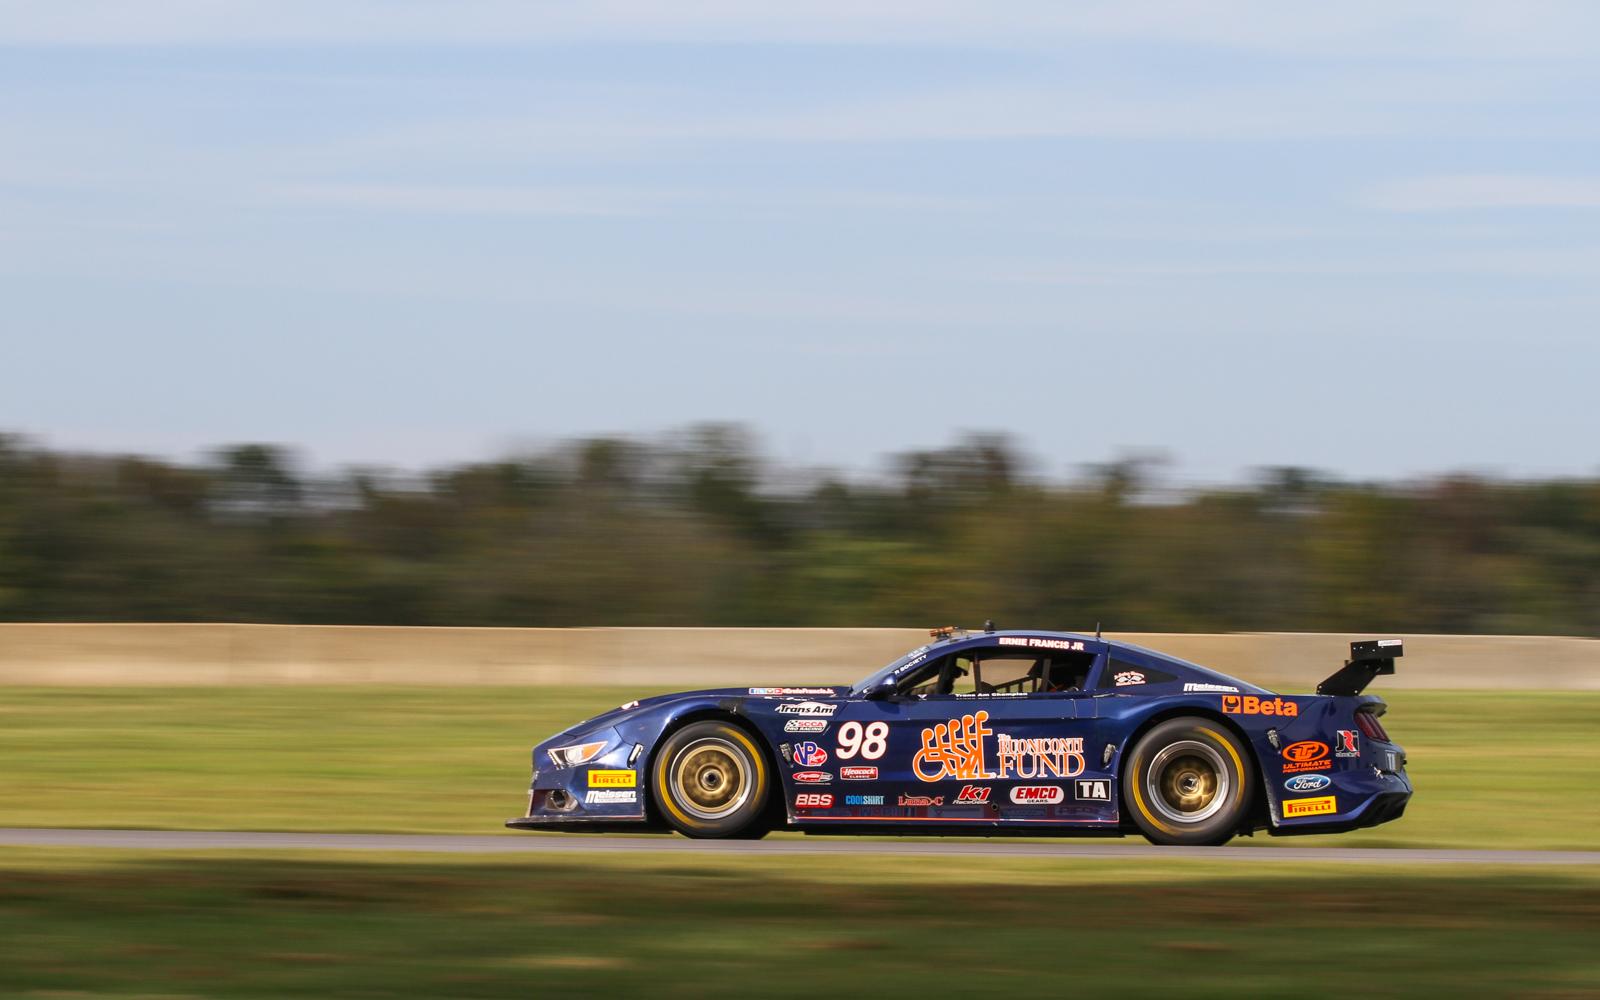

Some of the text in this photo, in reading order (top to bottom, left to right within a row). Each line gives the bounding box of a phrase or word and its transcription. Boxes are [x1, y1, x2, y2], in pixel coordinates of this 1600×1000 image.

[999, 637, 1084, 651] ERNIE FRANCIS JR
[780, 704, 833, 714] Trans Am
[1243, 696, 1298, 716] Beta
[836, 721, 889, 760] 98
[997, 737, 1084, 754] BUONICONTI
[794, 741, 818, 766] VP
[997, 752, 1085, 778] FUND
[1282, 760, 1332, 770] ULTIMATE
[592, 774, 632, 784] PIRELLI
[1293, 777, 1322, 790] Ford
[958, 785, 992, 801] K1
[1015, 787, 1058, 799] EMCO
[1080, 782, 1107, 799] TA
[795, 794, 833, 806] BBS
[845, 795, 885, 805] COOLSHIRT
[1288, 800, 1331, 813] PIRELLI
